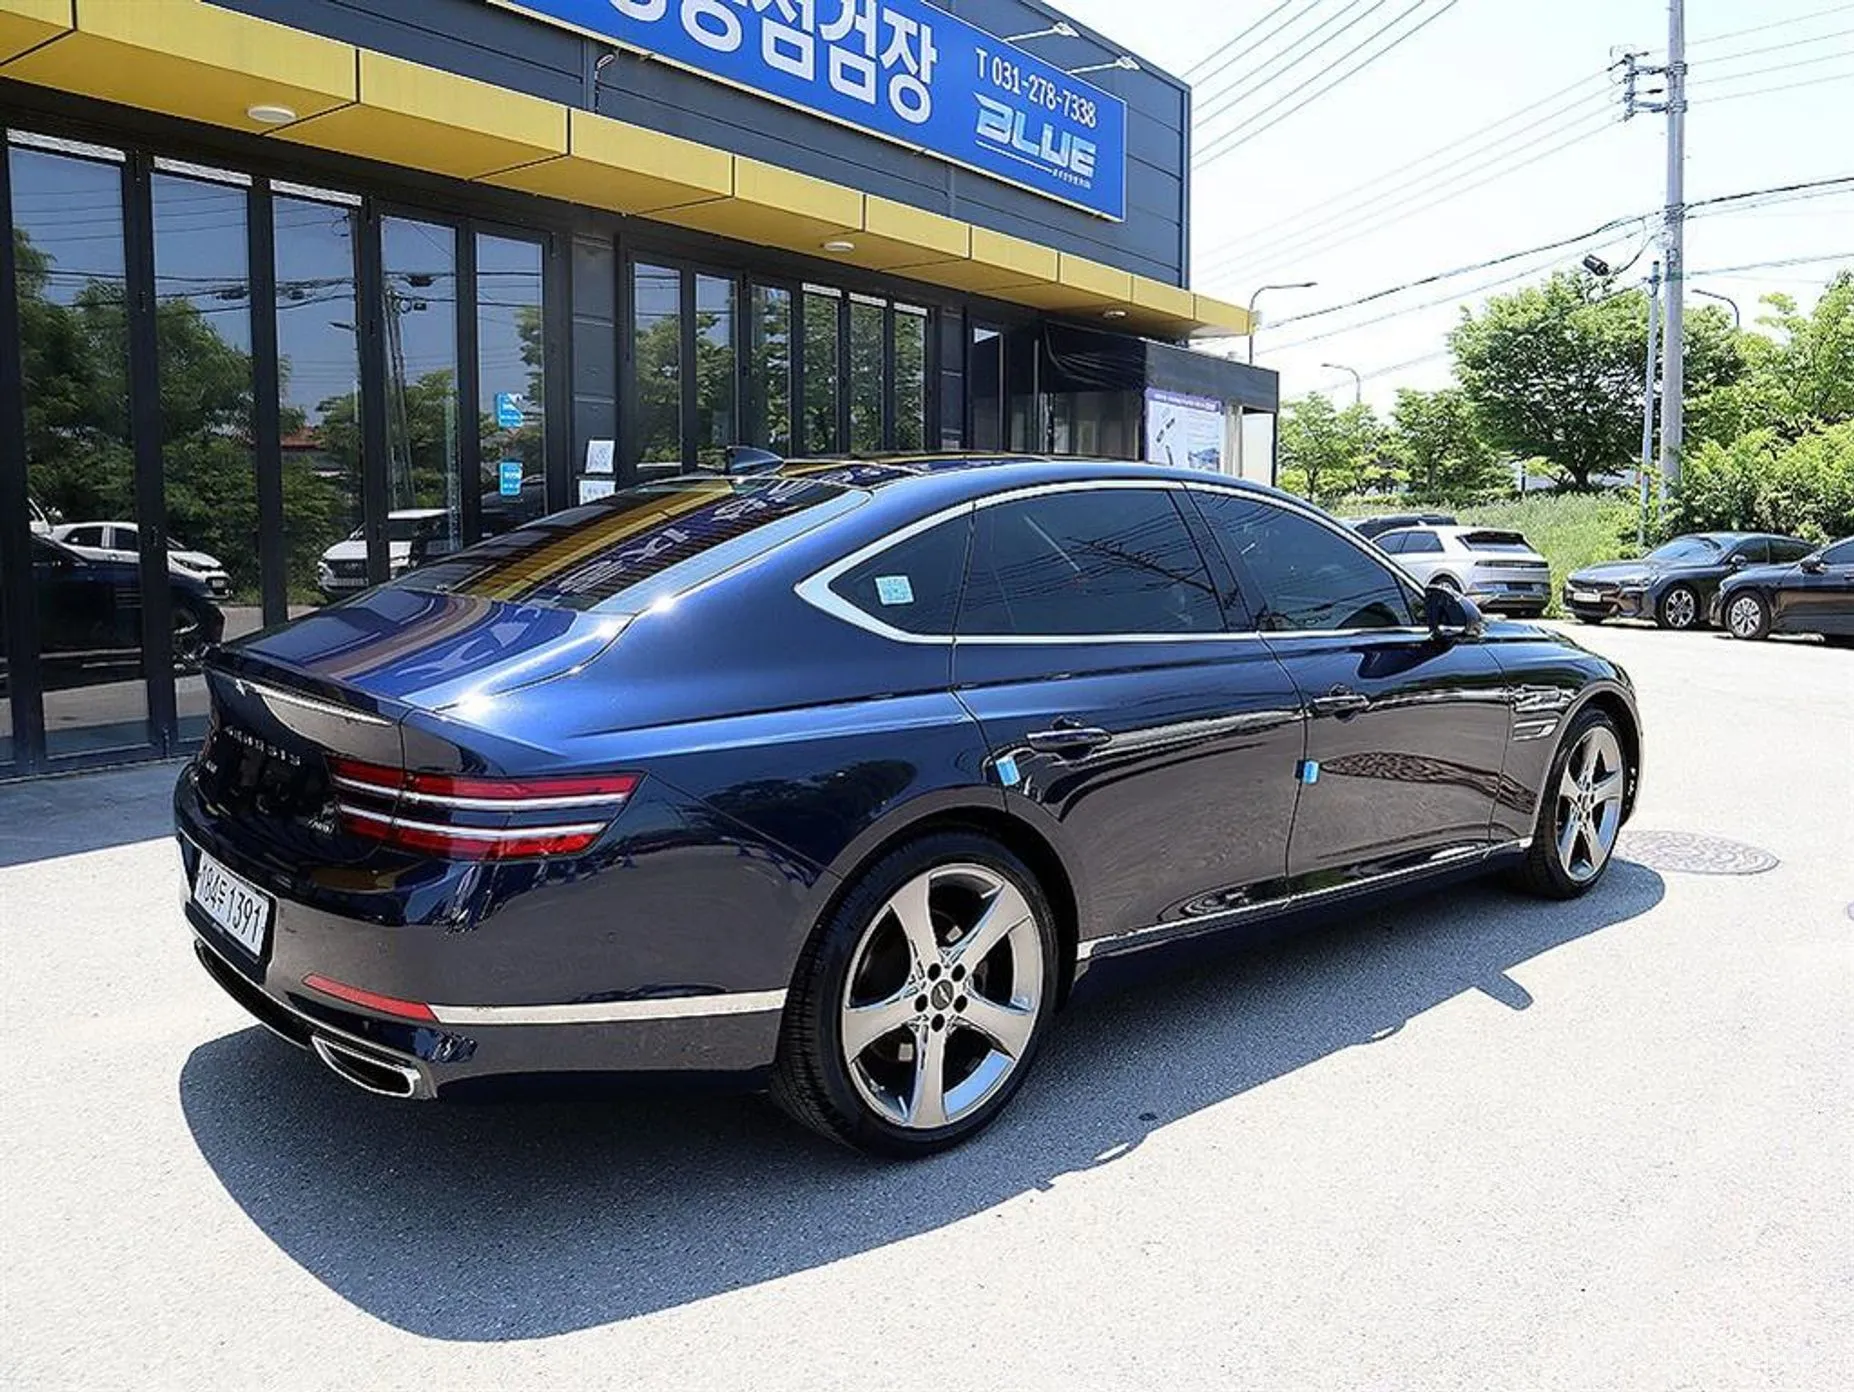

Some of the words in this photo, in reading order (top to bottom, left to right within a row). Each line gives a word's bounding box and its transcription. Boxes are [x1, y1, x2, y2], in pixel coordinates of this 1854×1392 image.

[975, 47, 988, 79] T
[991, 56, 1097, 128] 031-278-7338
[973, 91, 1096, 178] BLUE
